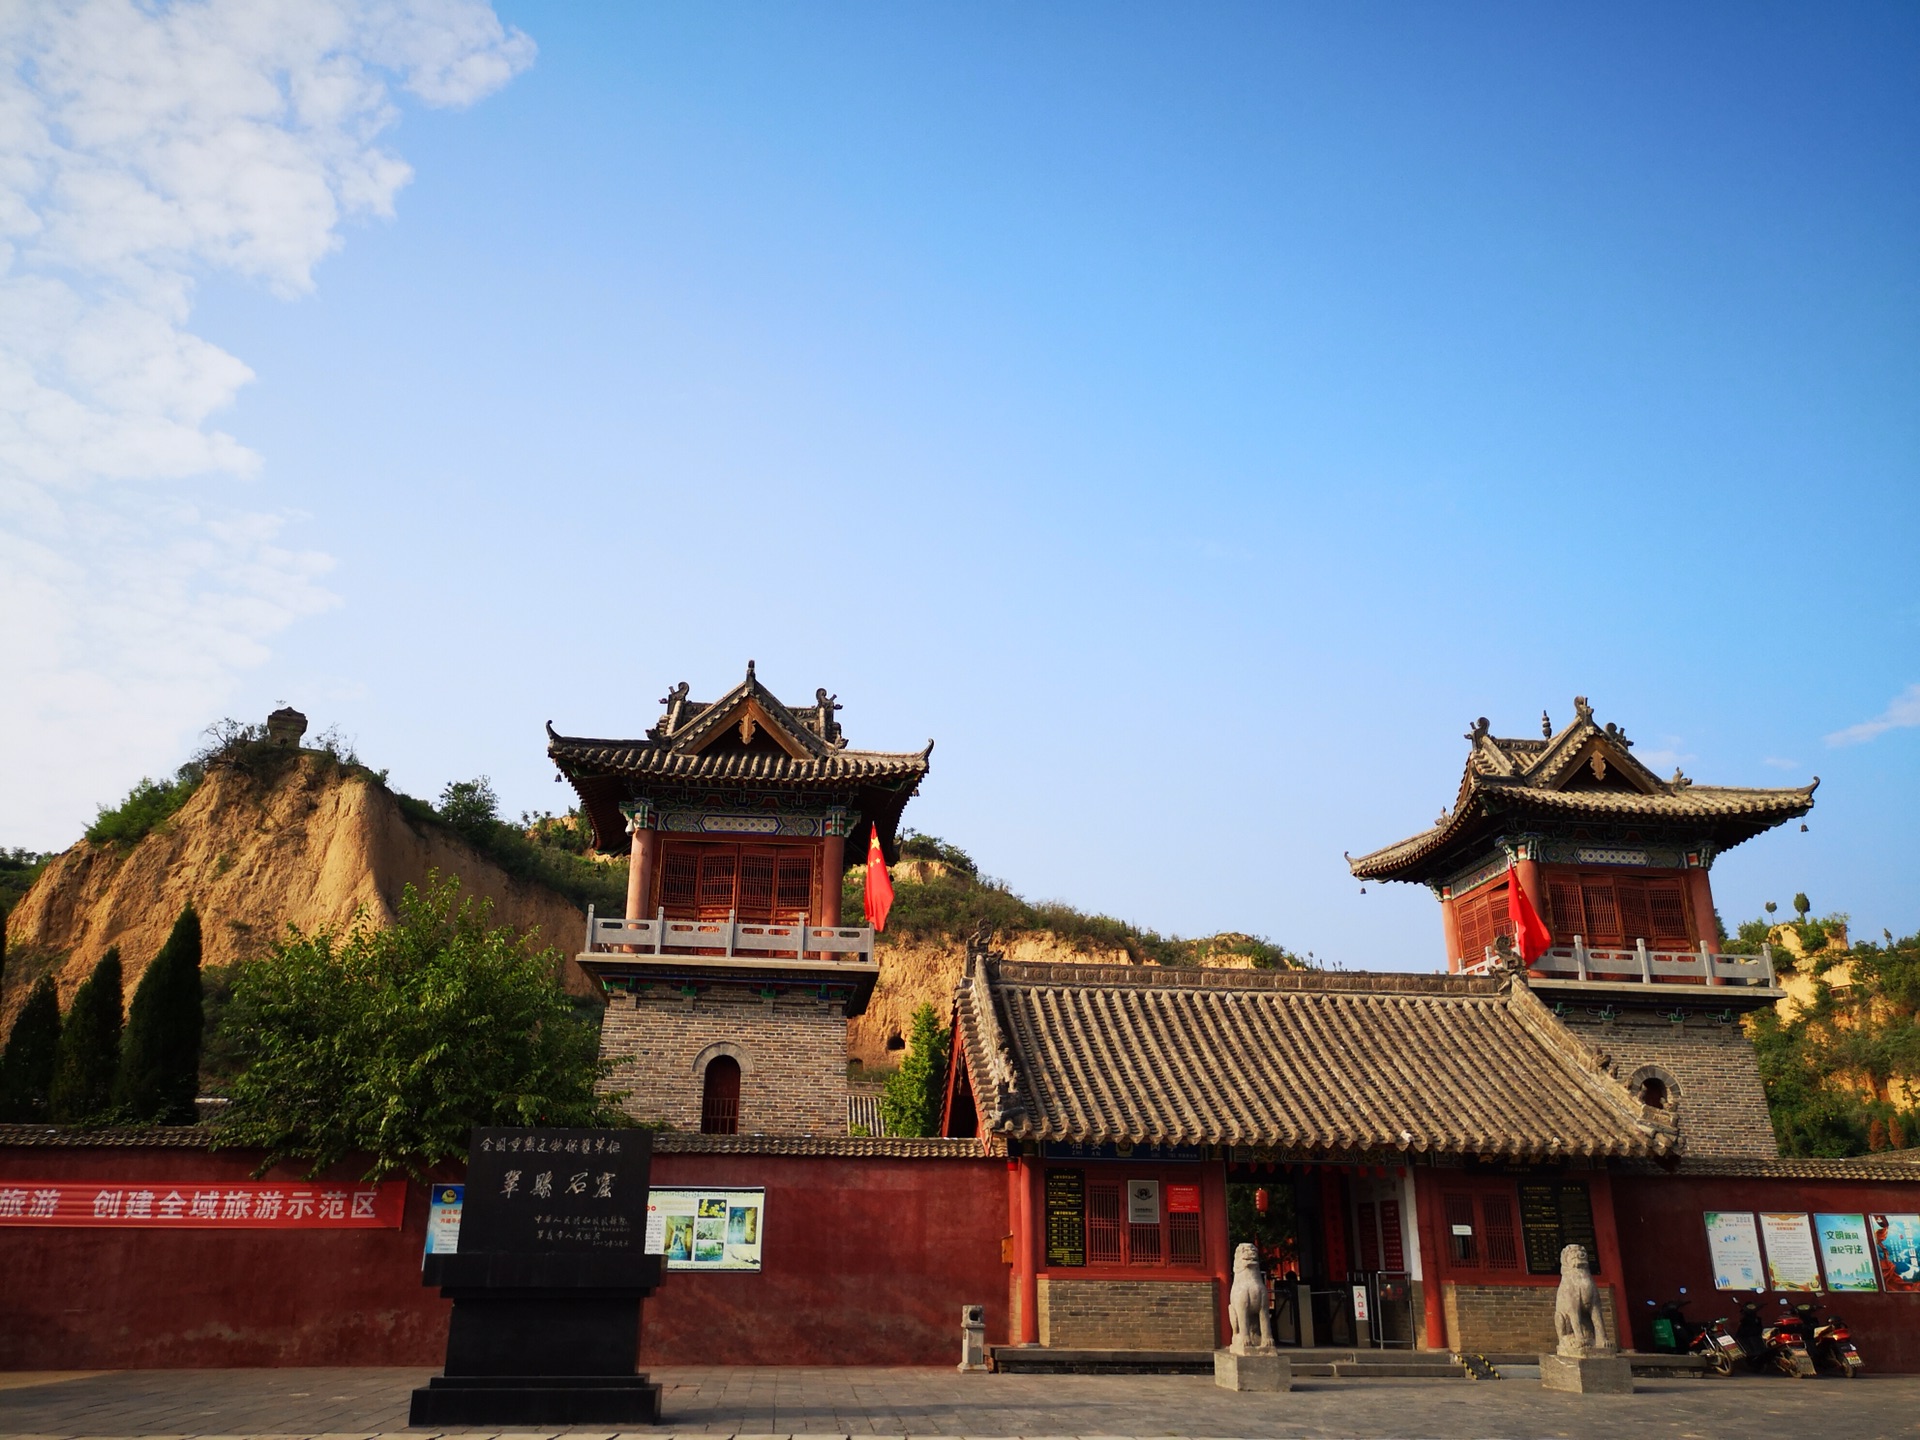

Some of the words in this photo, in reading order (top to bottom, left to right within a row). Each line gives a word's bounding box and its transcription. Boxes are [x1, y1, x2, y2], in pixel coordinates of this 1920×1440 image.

[0, 1187, 62, 1219] 旅游
[92, 1188, 378, 1220] 创建全域旅游示范区
